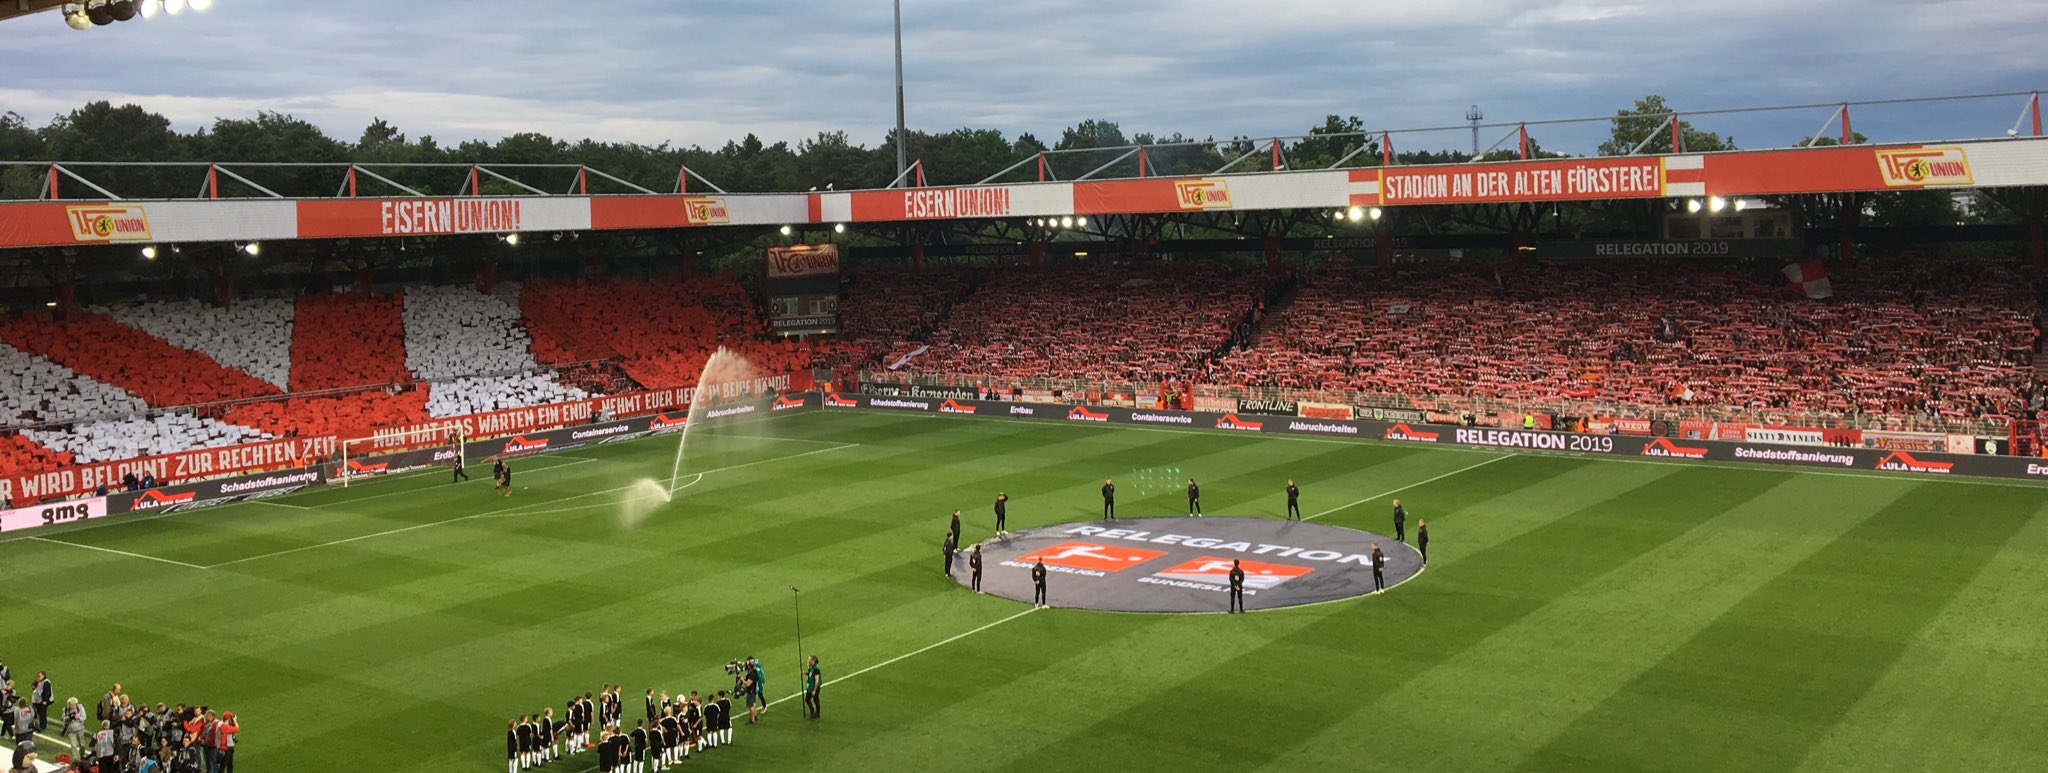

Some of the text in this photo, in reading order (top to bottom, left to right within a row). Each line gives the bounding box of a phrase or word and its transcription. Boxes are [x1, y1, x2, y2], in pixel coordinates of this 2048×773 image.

[1929, 162, 1966, 176] UNION
[1386, 165, 1659, 199] STADION AN DER ALTEN FÖRSTEREI
[1206, 190, 1228, 202] UNION
[904, 188, 1010, 218] EISERN UNION!
[381, 200, 521, 234] EISERN UNION!
[709, 207, 727, 218] UNION
[114, 218, 146, 232] UNION
[1596, 241, 1729, 255] RELEGATION 2019
[804, 253, 838, 269] UNION
[773, 317, 836, 327] RELEGATION 2019
[772, 402, 786, 411] LULA
[825, 399, 838, 407] LULA
[870, 398, 929, 410] Schadstoffsanierung
[1239, 399, 1294, 412] FRONTLINE
[373, 426, 405, 449] NUN
[410, 421, 438, 445] HAT
[443, 417, 473, 440] DAS
[478, 408, 535, 434] WARTEN
[537, 405, 556, 426] EIN
[601, 394, 641, 416] NEHMT
[645, 389, 673, 410] EUER
[676, 386, 705, 405] HERZ
[708, 383, 720, 400] IN
[722, 380, 751, 398] BEIDE
[754, 374, 790, 394] HÄNDE!
[706, 404, 755, 419] Abbrucharbeiten
[1010, 405, 1034, 415] Erdbau
[1069, 413, 1085, 421] LULA
[1131, 412, 1193, 424] Containerservice
[571, 424, 629, 440] Containerservice
[650, 421, 666, 430] LULA
[1217, 422, 1236, 430] LULA
[1288, 421, 1358, 434] Abbrucharbeiten
[1387, 432, 1408, 441] LULA
[1456, 428, 1614, 452] RELEGATION 2019
[1747, 432, 1822, 442] SIXTY NINERS
[505, 444, 523, 453] LULA
[1644, 447, 1670, 457] LULA
[433, 450, 463, 461] Erdb
[1734, 447, 1854, 466] Schadstoffsanierung
[20, 470, 75, 498] WIRD
[81, 457, 169, 490] BELOHNT
[175, 452, 213, 477] ZUR
[218, 440, 297, 470] RECHTEN
[302, 435, 337, 459] ZEIT
[1880, 461, 1909, 471] LULA
[220, 471, 318, 493] Schadstoffsanierung
[134, 499, 159, 510] LULA
[41, 504, 89, 525] gmg
[1064, 525, 1391, 567] RELEGATION
[1000, 560, 1106, 577] BUNESLIGA
[1137, 576, 1257, 596] BUNDESLIA
